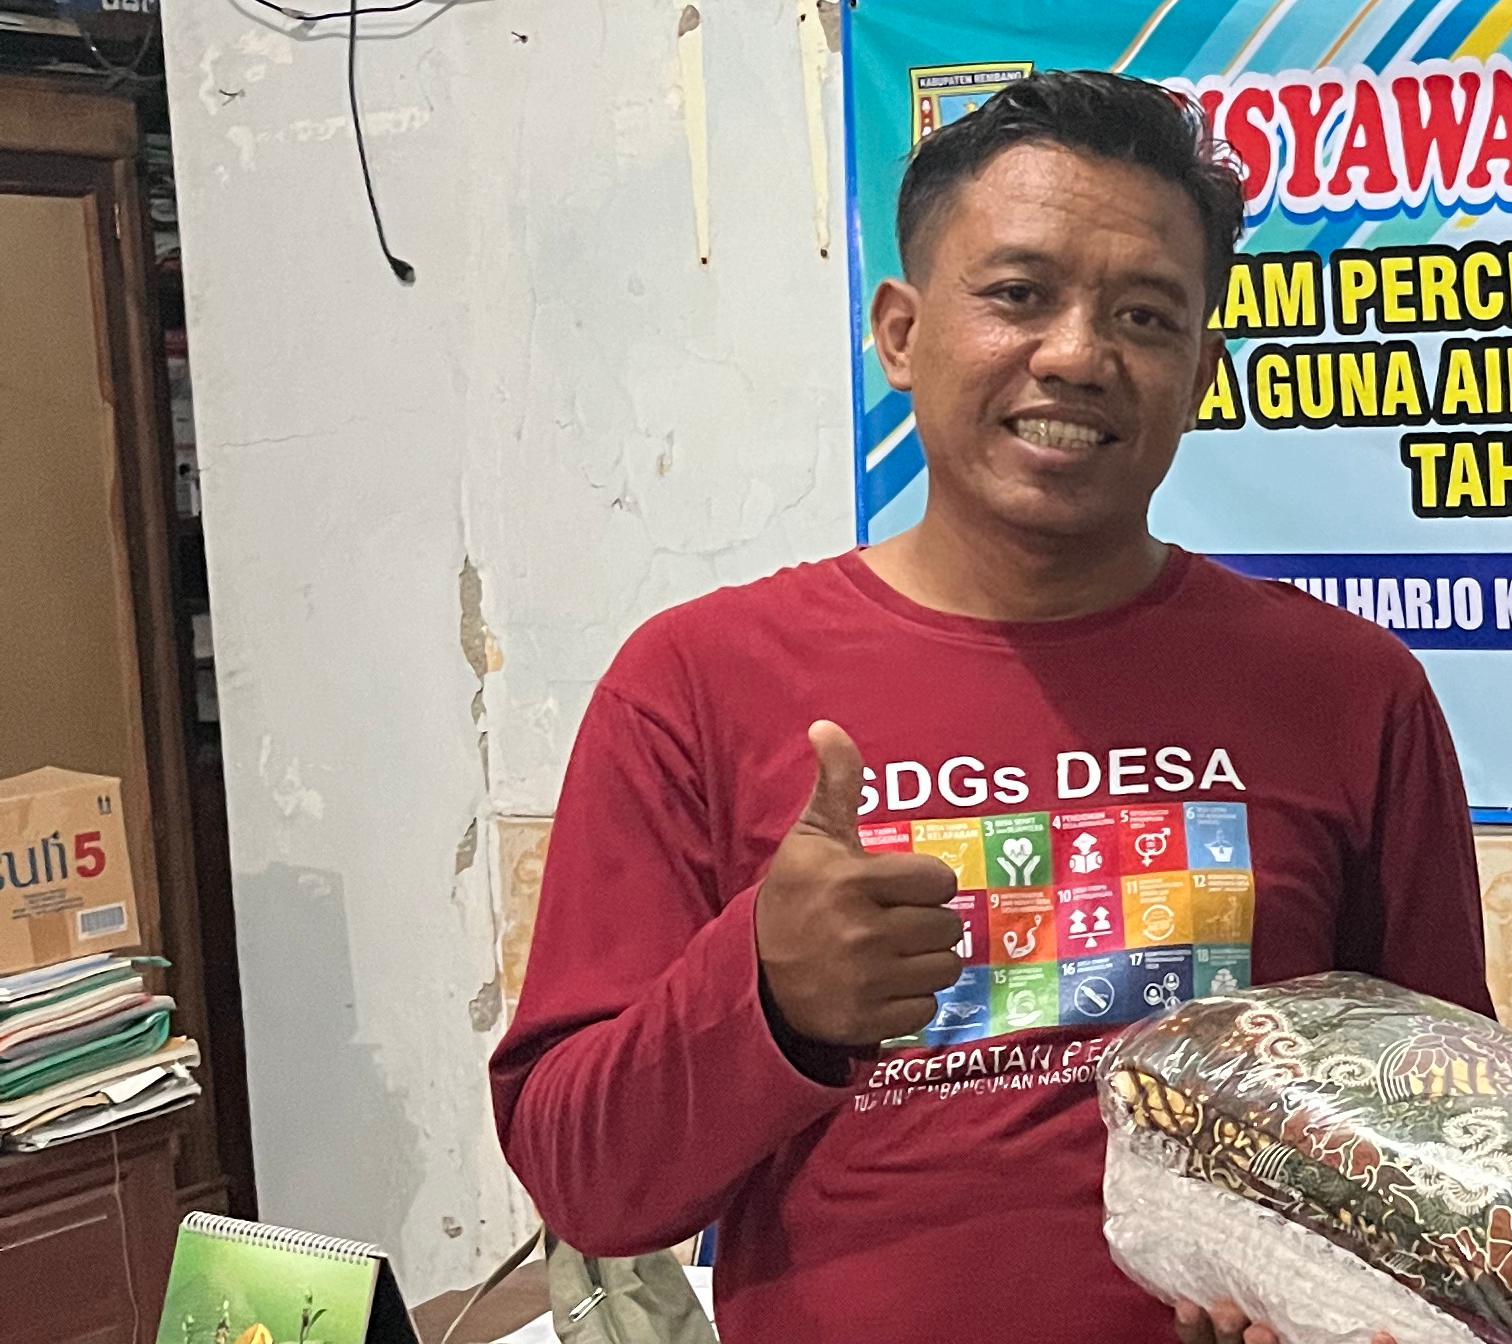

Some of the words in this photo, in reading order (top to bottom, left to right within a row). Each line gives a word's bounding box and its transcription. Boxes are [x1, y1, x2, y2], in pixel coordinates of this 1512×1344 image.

[1207, 262, 1317, 330] AM
[1256, 351, 1422, 420] GUNA
[1055, 746, 1247, 799] DESA
[1120, 809, 1130, 823] 5
[1186, 806, 1196, 819] 6
[984, 820, 995, 837] 3
[1052, 815, 1062, 830] 4
[915, 825, 926, 842] 2
[74, 831, 106, 878] 5
[1126, 880, 1139, 896] 11
[1193, 874, 1207, 889] 12
[990, 893, 1000, 908] 9
[1058, 889, 1073, 903] 10
[1129, 952, 1144, 967] 17
[993, 969, 1007, 985] 15
[1062, 962, 1076, 977] 16
